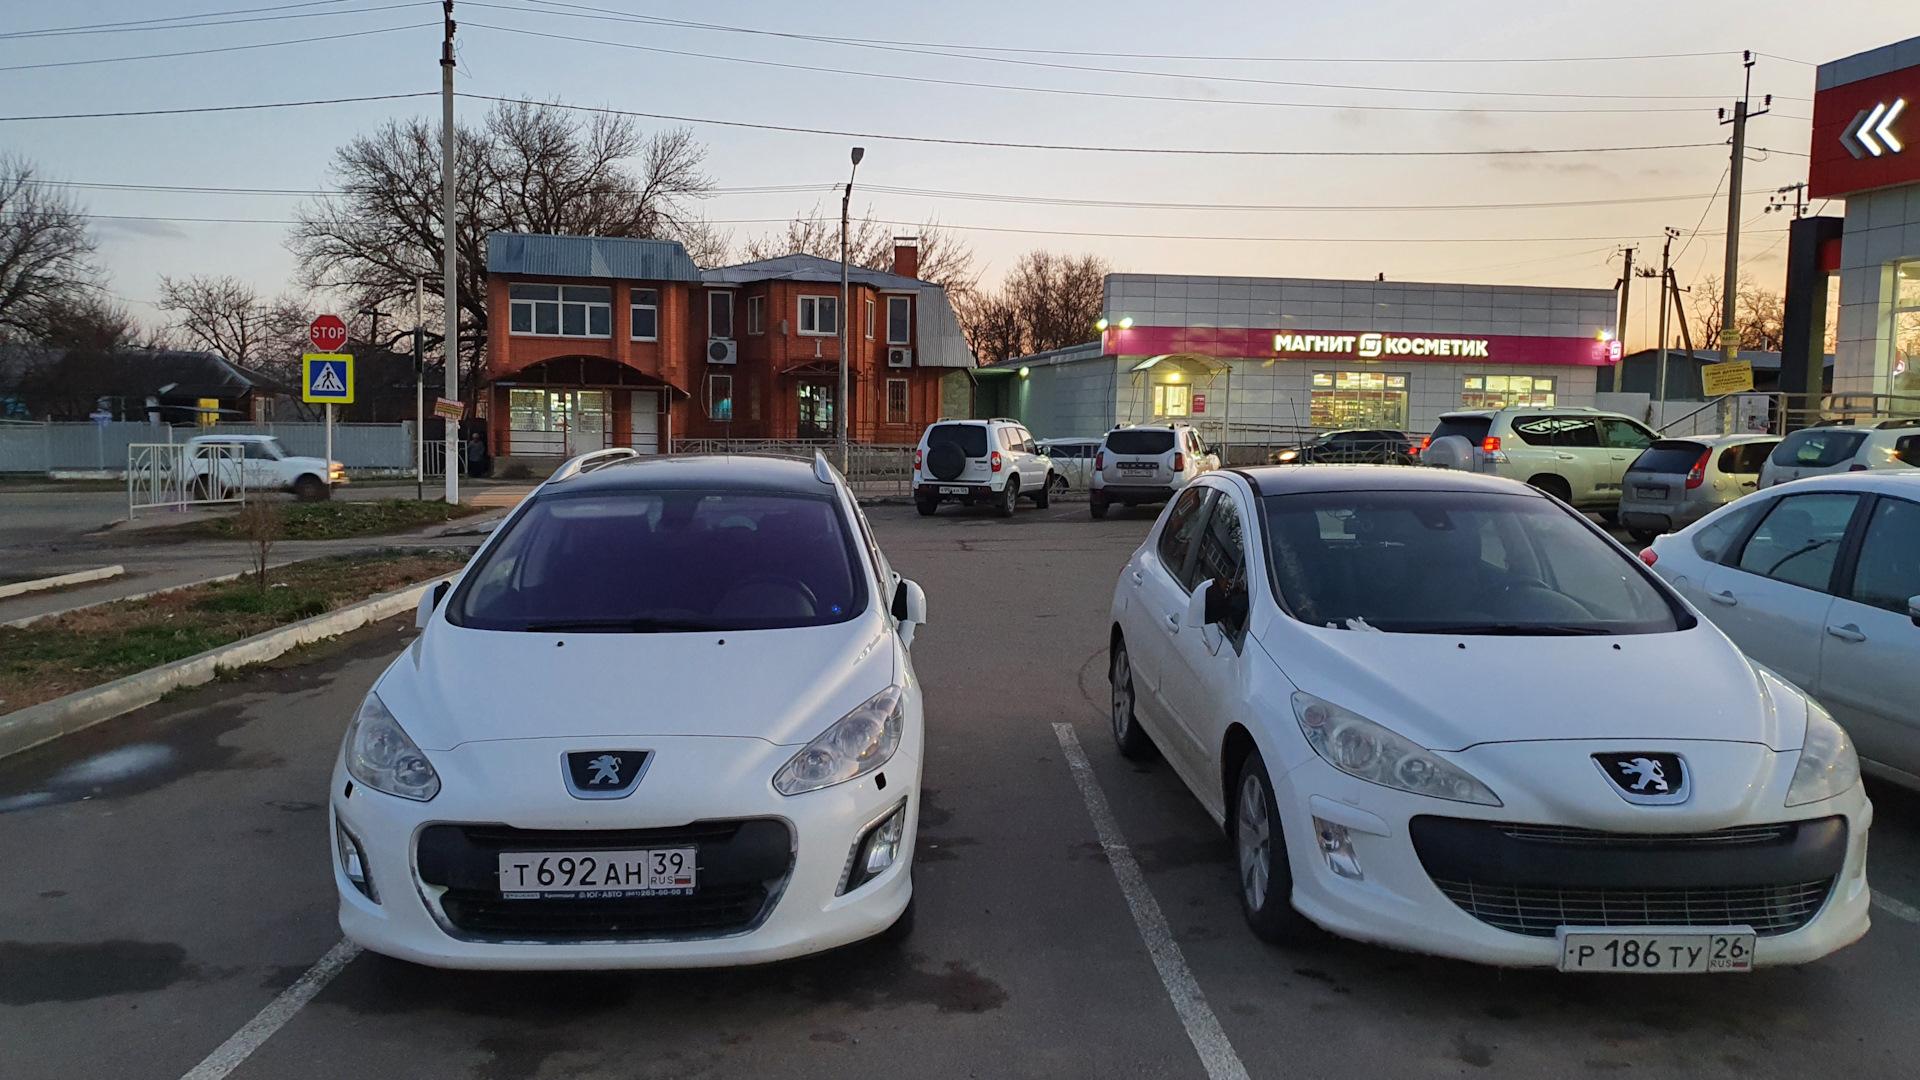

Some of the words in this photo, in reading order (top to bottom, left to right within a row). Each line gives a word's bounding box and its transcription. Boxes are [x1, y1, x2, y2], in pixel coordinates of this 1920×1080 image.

[312, 326, 345, 339] STOP
[1274, 334, 1356, 352] МАГНИТ
[1384, 337, 1489, 357] КОСМЕТИК
[653, 853, 684, 875] 39
[650, 876, 673, 885] RUS
[1714, 937, 1744, 959] 26
[1710, 959, 1732, 968] RUS
